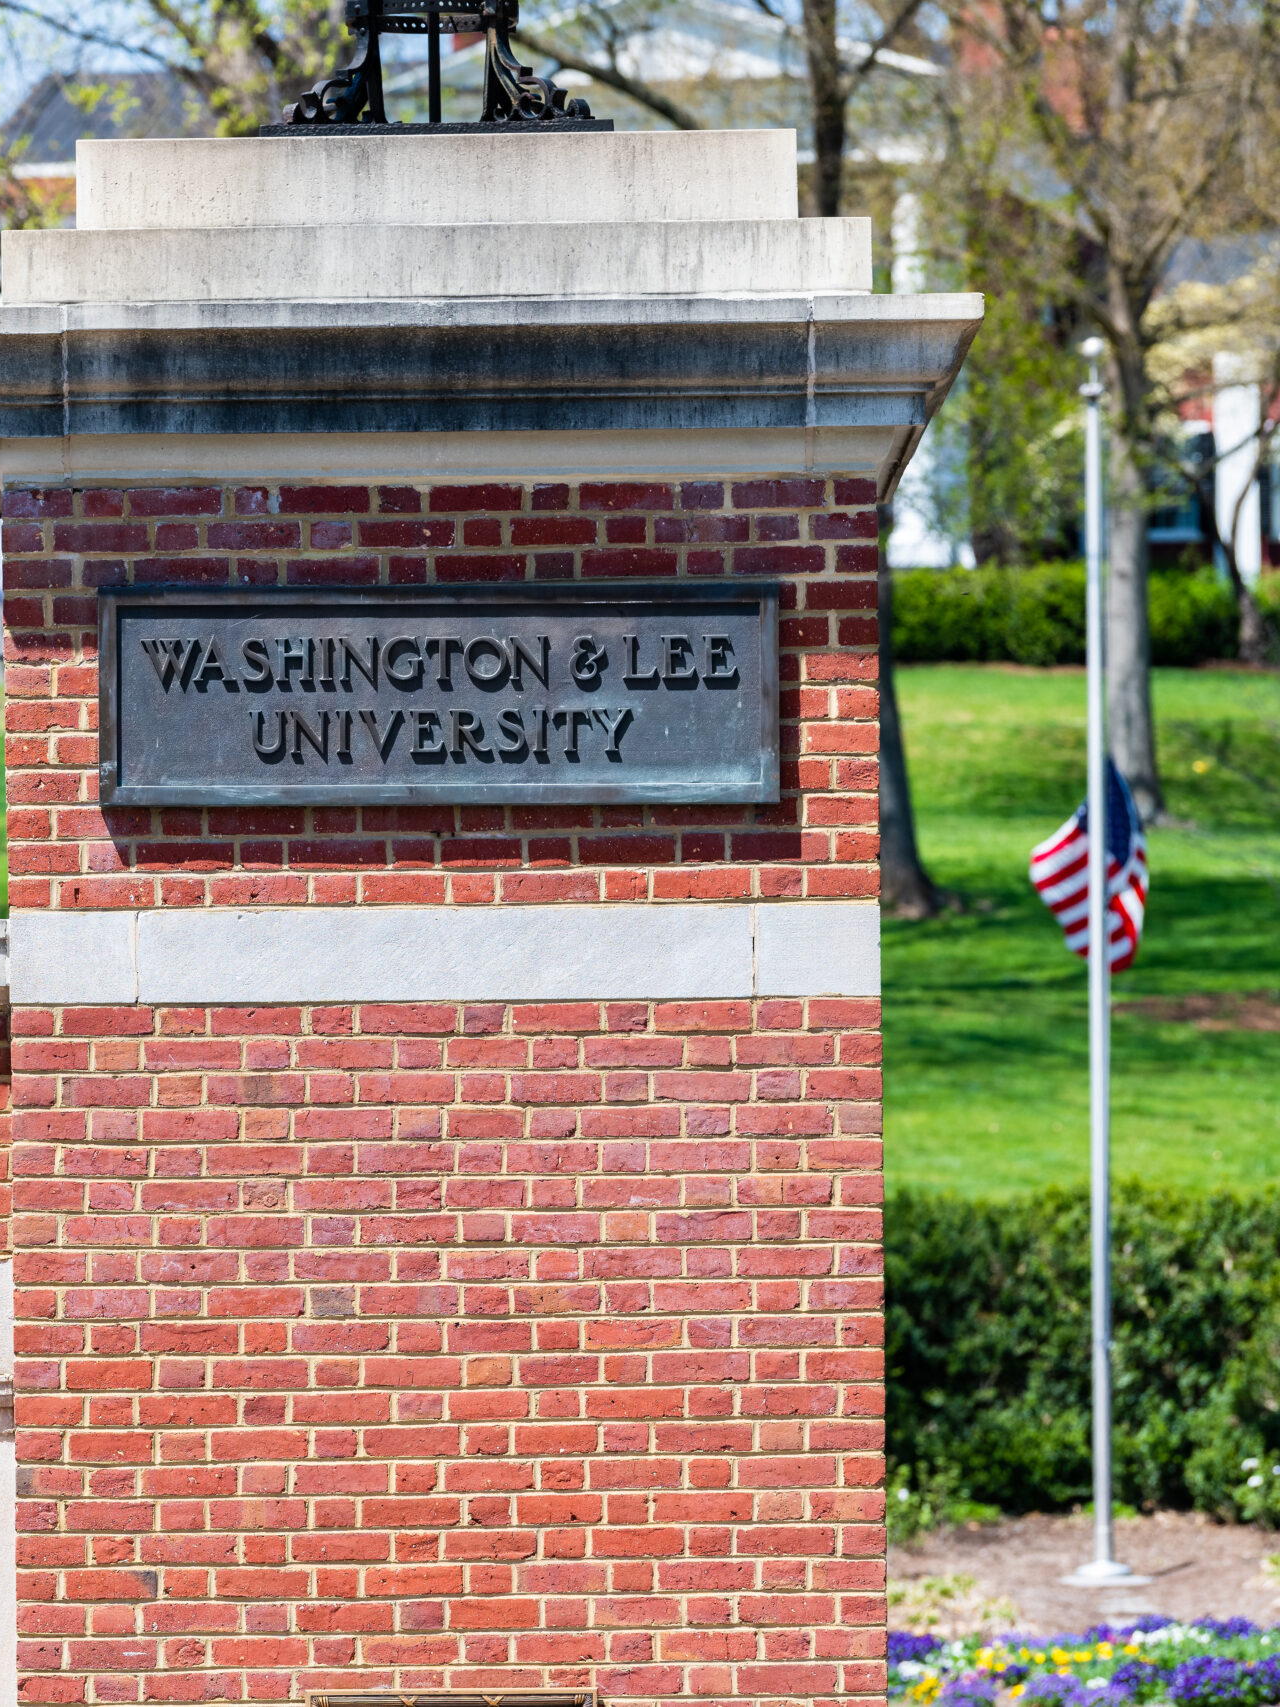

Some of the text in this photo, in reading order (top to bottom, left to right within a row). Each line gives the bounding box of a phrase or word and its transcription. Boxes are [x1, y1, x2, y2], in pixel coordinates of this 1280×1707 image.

[140, 634, 741, 690] WASHINGTON & LEE
[249, 708, 632, 758] UNIVERSITY
